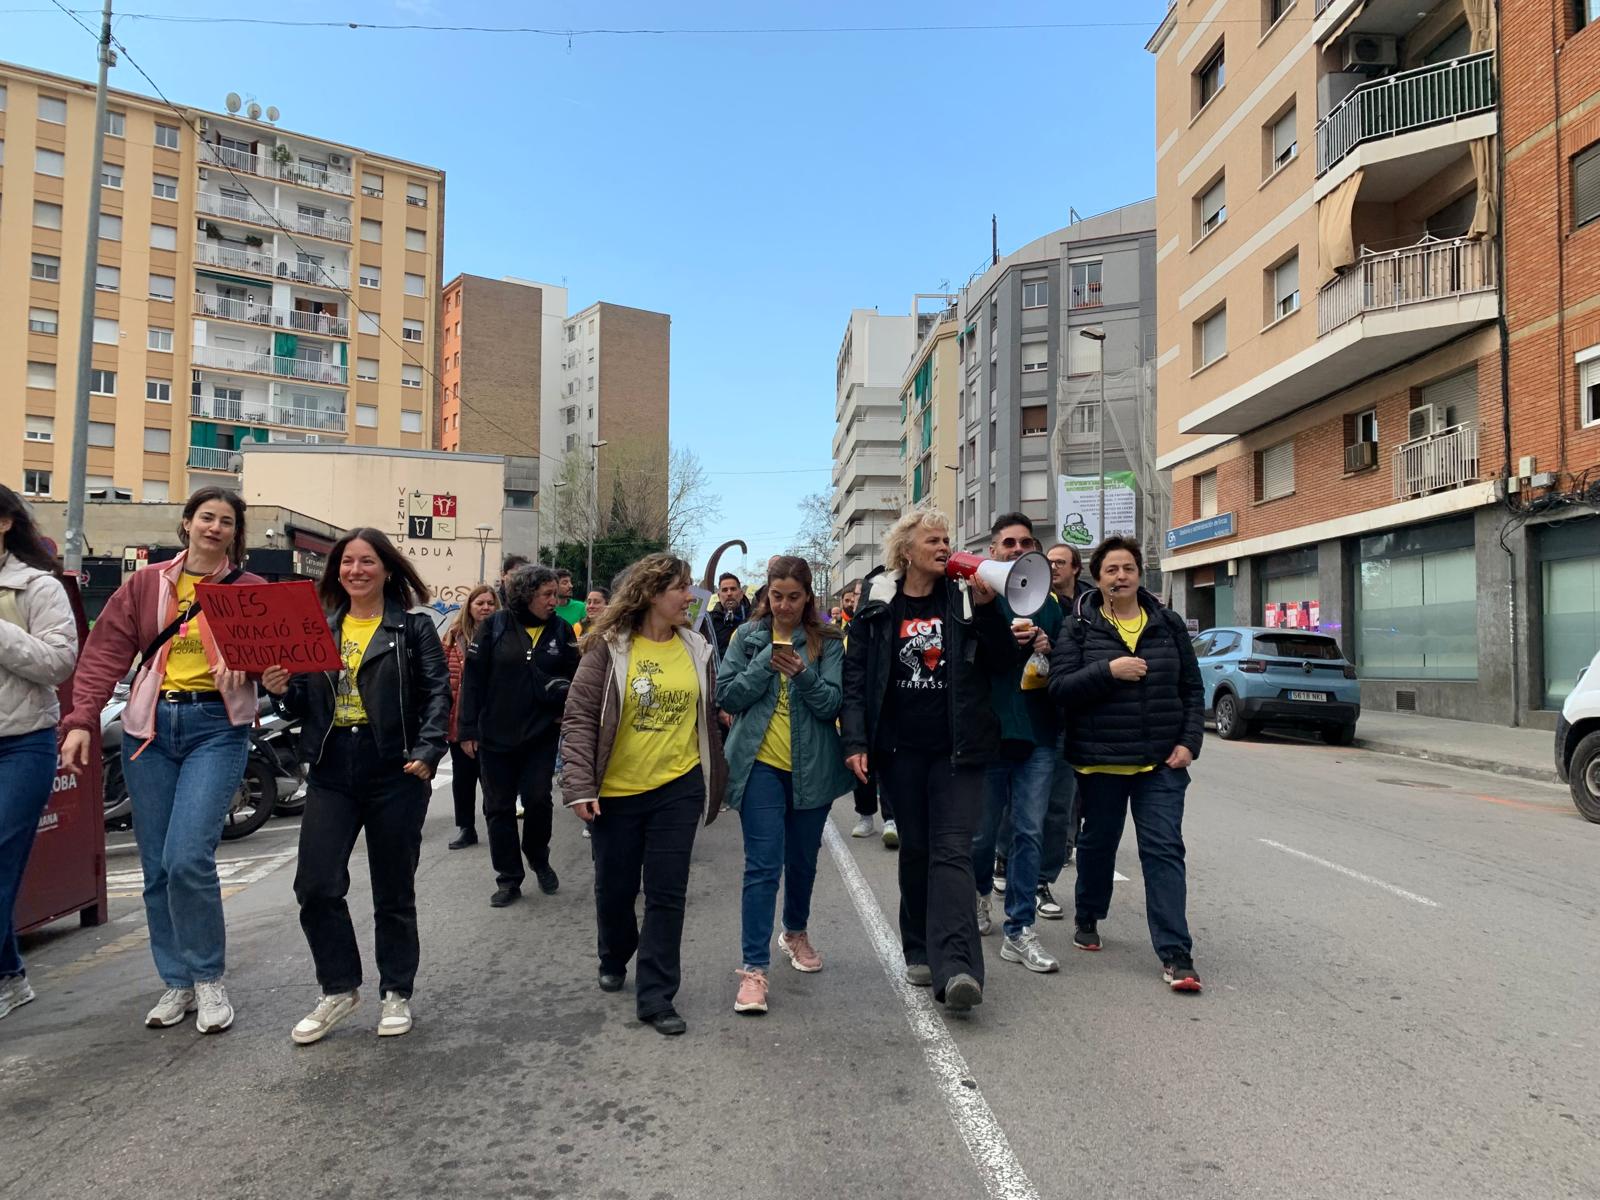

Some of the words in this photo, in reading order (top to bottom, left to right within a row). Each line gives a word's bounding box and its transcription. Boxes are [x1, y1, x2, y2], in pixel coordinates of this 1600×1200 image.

[206, 593, 235, 618] NO
[237, 590, 268, 618] ÉS
[301, 617, 325, 635] ÉS
[906, 618, 943, 636] CGT
[223, 639, 328, 666] EXPLOTACIÓ
[51, 773, 77, 792] OBA
